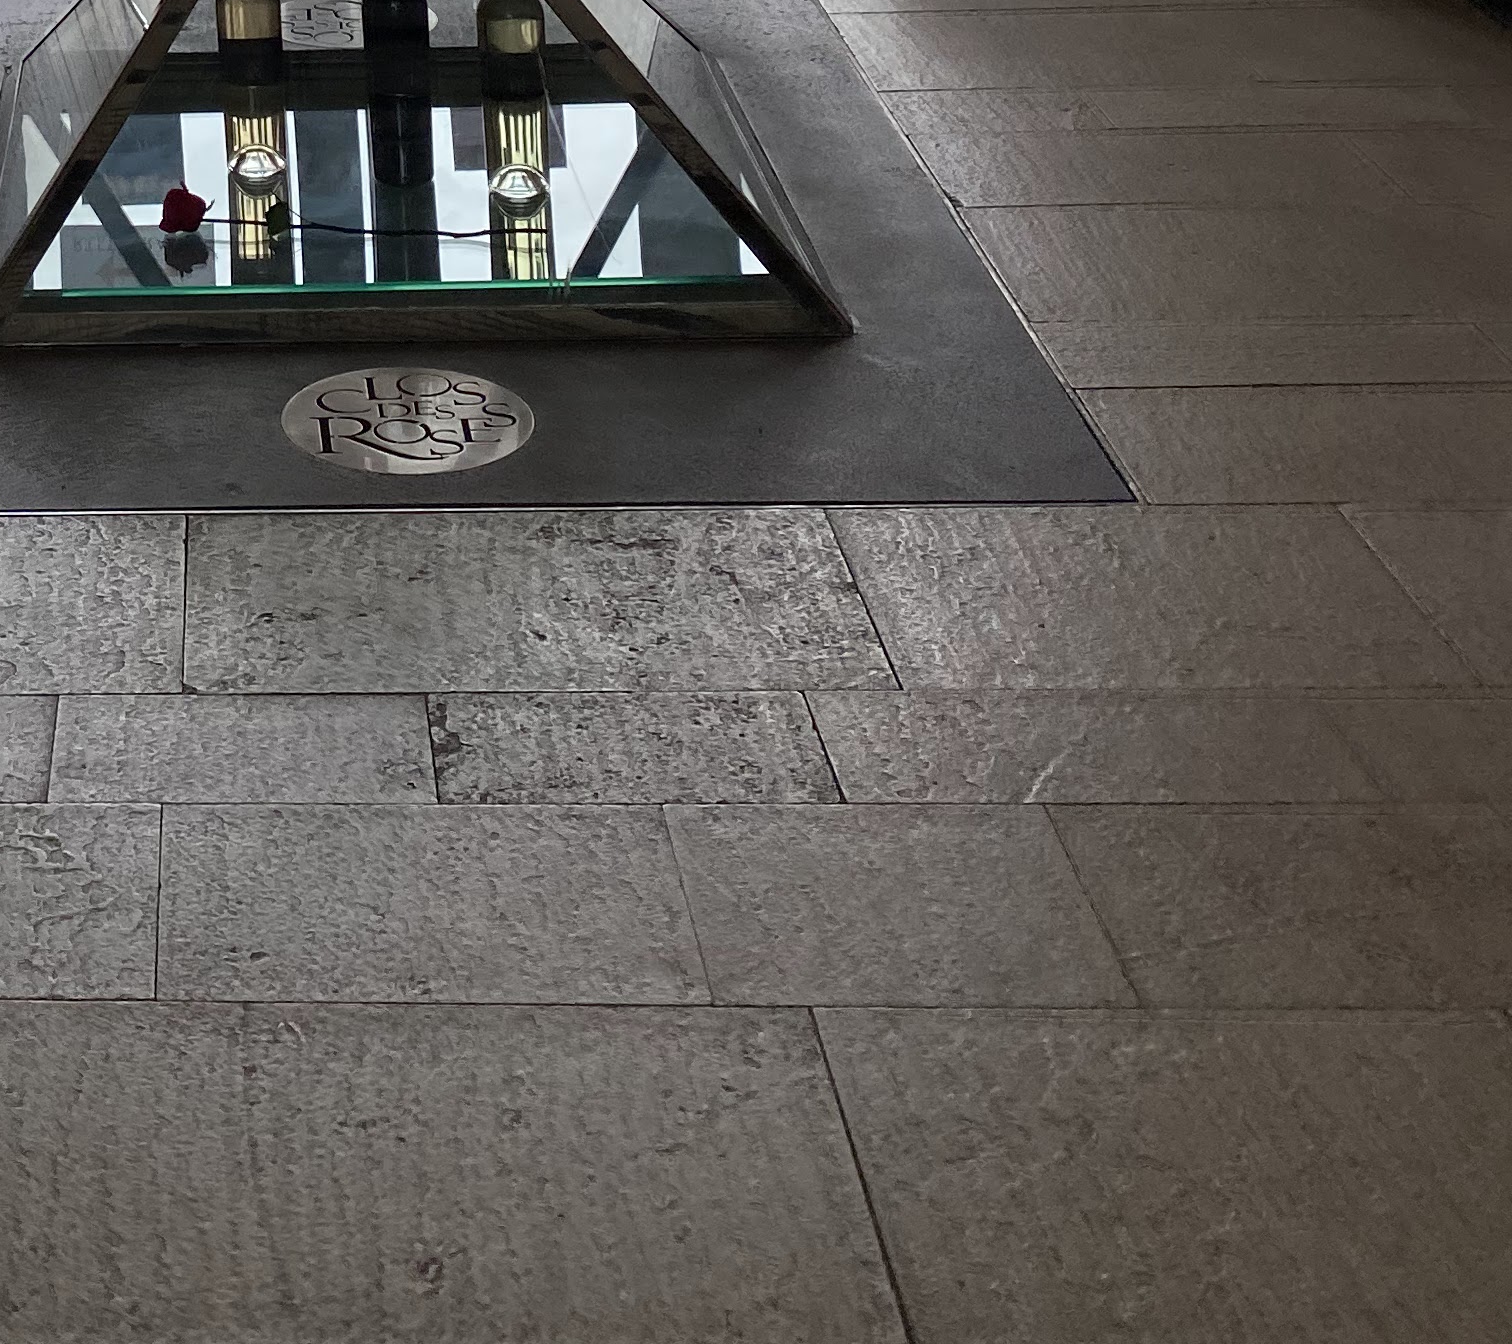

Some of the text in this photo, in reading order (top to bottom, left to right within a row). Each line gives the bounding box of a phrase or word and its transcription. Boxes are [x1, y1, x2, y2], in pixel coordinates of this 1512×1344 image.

[316, 373, 487, 414] CLOS
[377, 400, 456, 420] DES
[309, 402, 518, 461] ROSES
